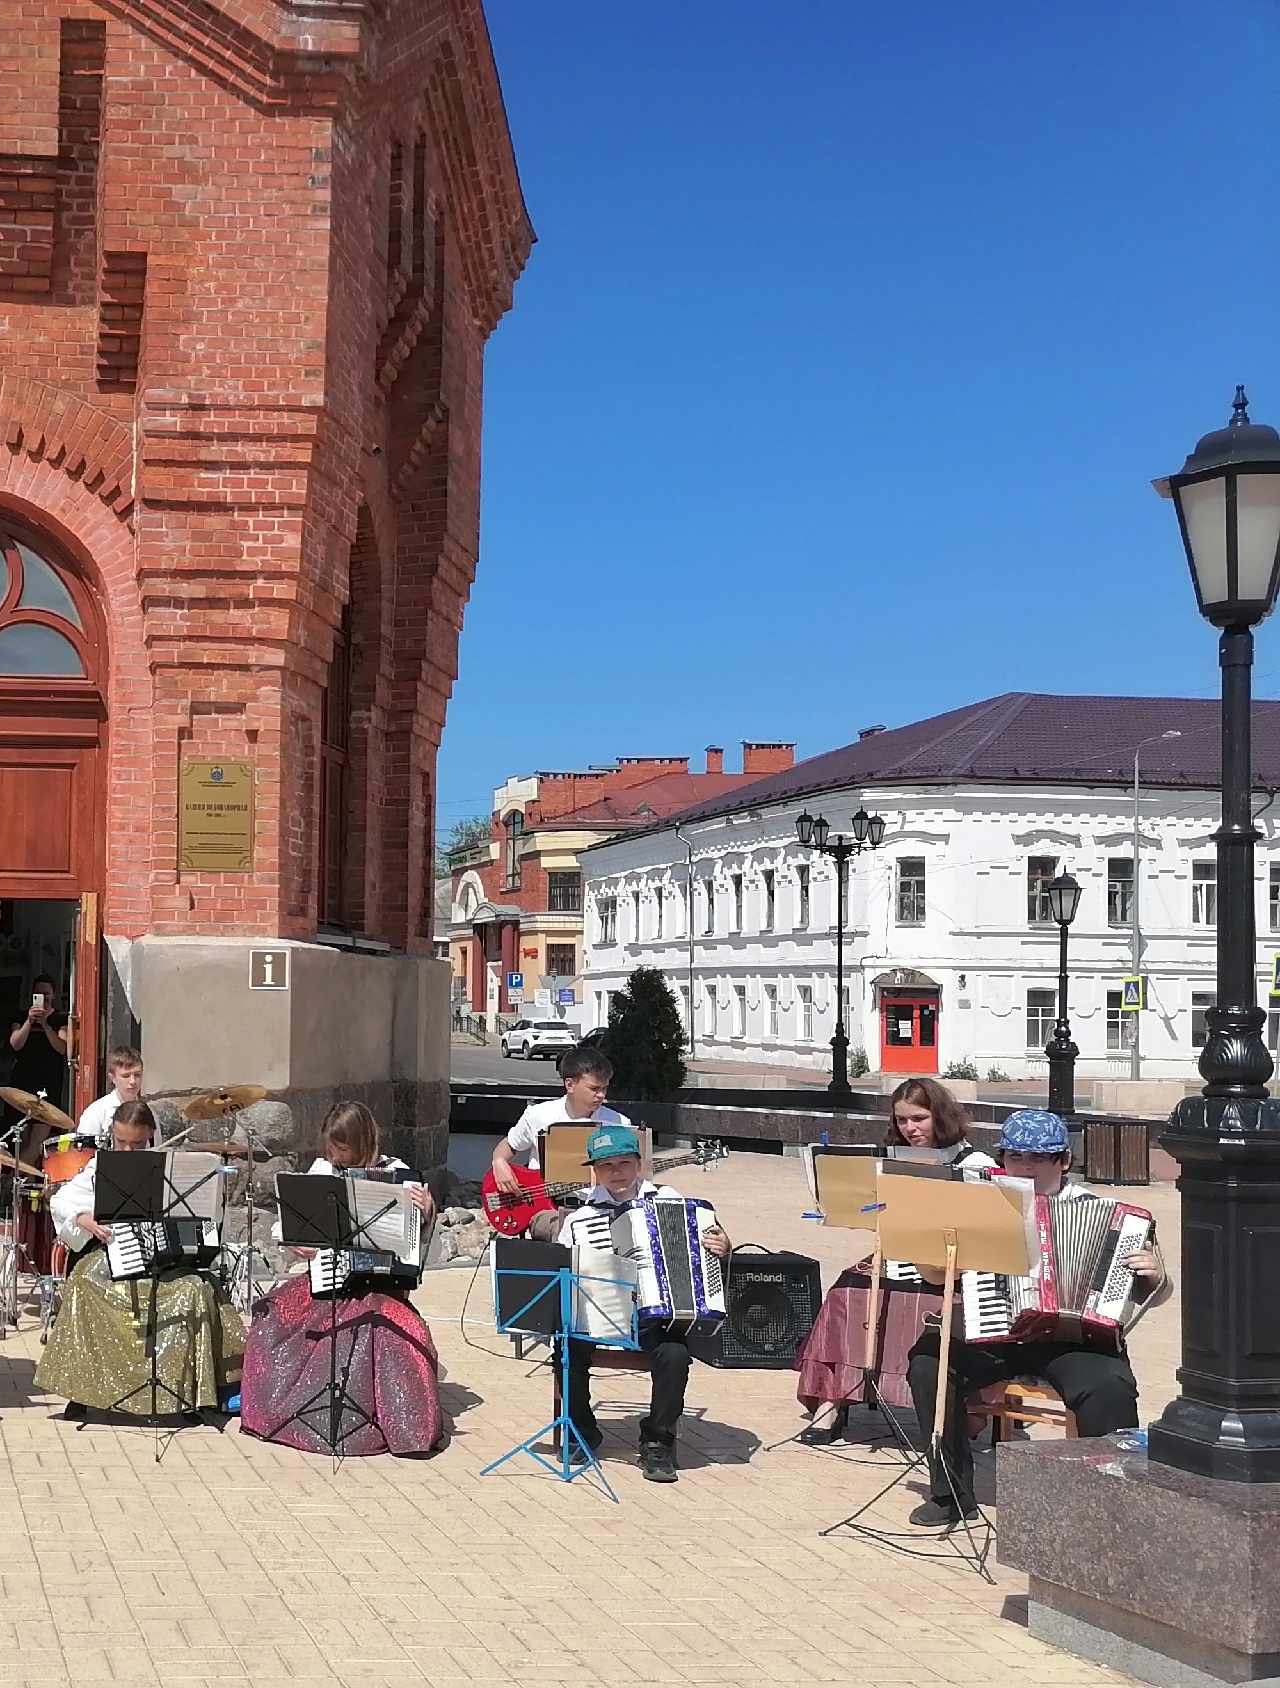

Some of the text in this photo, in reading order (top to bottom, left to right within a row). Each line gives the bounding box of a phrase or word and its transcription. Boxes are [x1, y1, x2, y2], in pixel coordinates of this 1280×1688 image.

[262, 954, 275, 985] i
[512, 974, 521, 986] P
[746, 1272, 783, 1282] Roland
